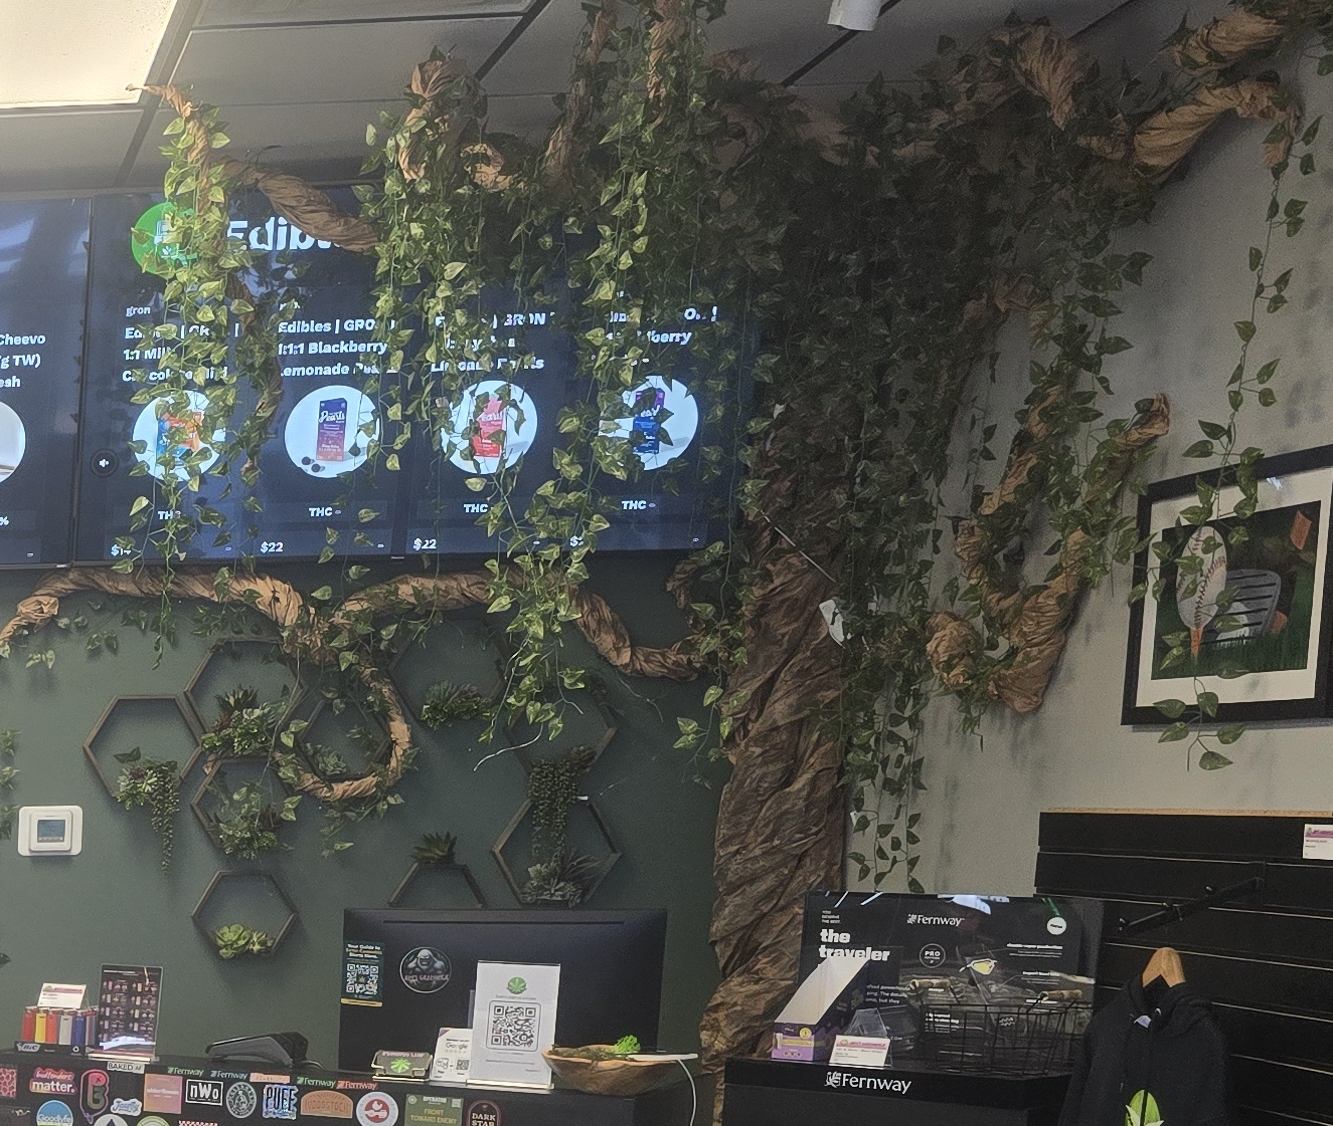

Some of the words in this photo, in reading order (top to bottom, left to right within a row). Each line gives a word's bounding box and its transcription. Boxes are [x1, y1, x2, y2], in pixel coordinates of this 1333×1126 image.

[308, 342, 387, 356] Blackberry
[917, 914, 962, 926] Fernway
[820, 929, 850, 943] the
[819, 947, 890, 961] traveler
[174, 1067, 204, 1076] Fernway
[218, 1071, 247, 1079] Fernway
[32, 1081, 75, 1093] matter.
[304, 1078, 335, 1088] Fernway
[346, 1081, 377, 1090] Fernway
[842, 1075, 911, 1094] Fernway
[190, 1084, 219, 1099] nWo
[306, 1101, 351, 1111] WOODSTOCK
[472, 1113, 496, 1121] DARK
